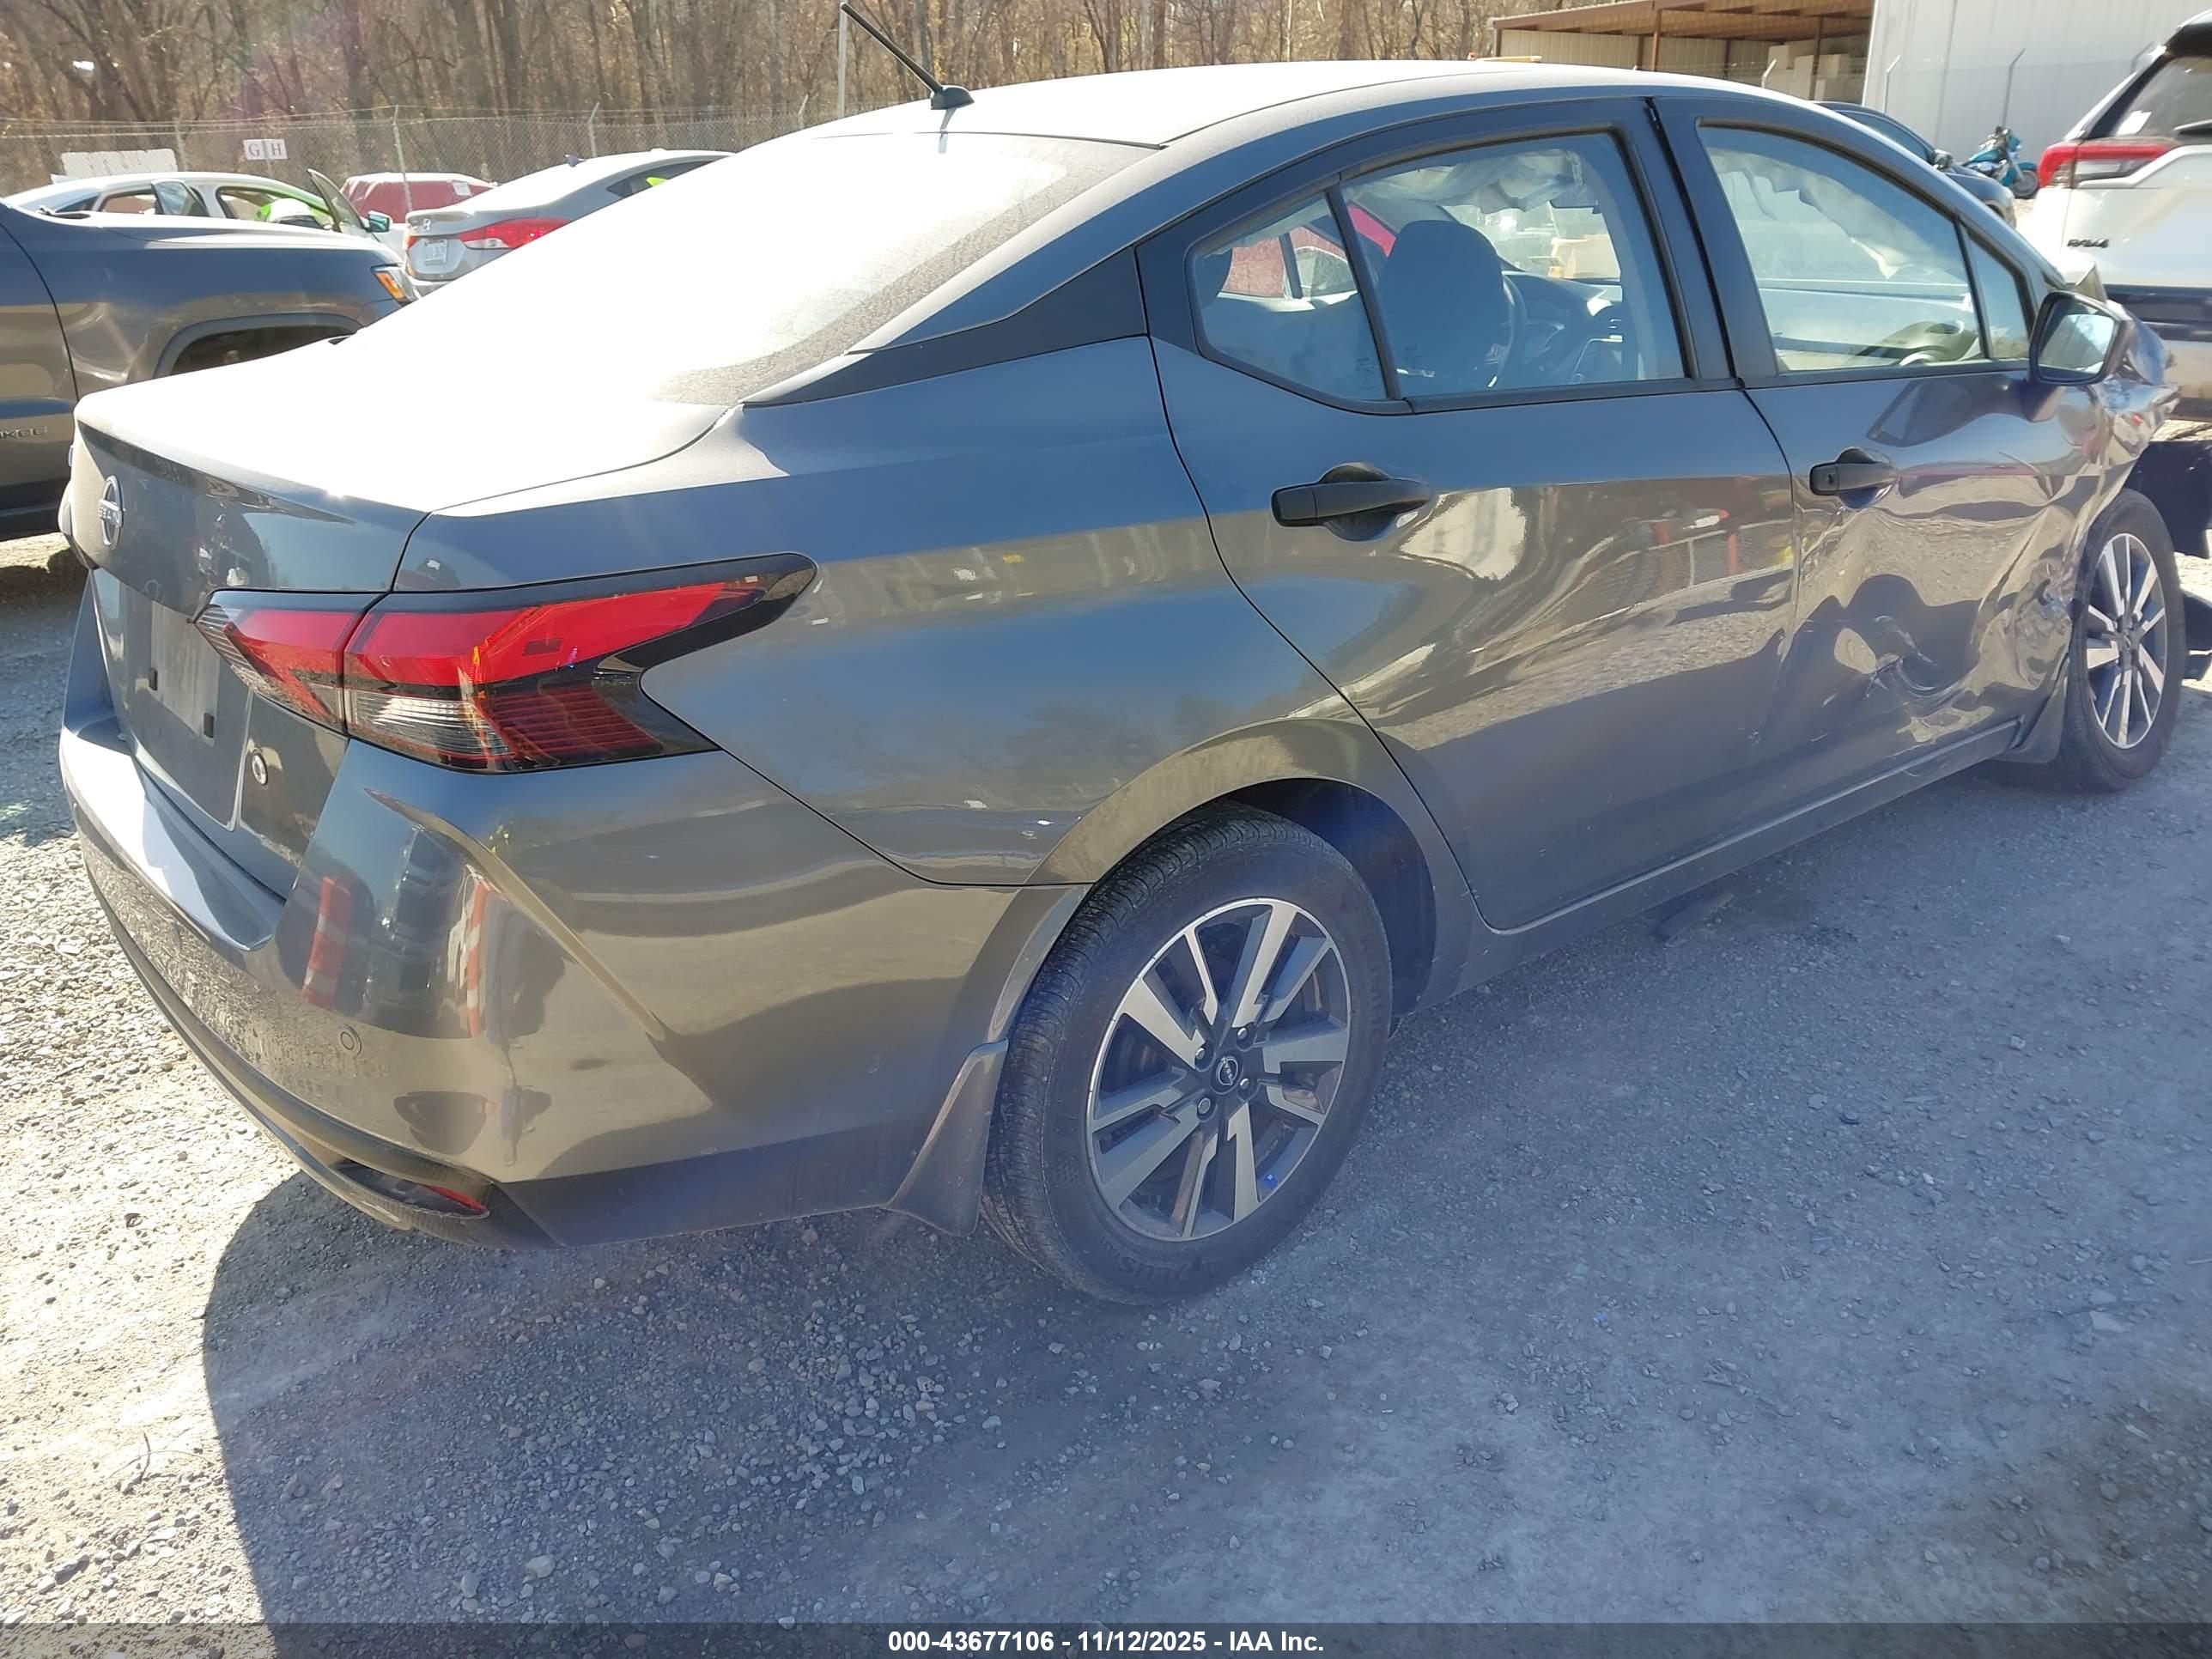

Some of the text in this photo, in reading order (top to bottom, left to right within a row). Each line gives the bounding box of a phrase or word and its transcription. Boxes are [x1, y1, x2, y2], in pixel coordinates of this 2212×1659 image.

[249, 143, 282, 156] G H
[2067, 239, 2109, 248] RAV4
